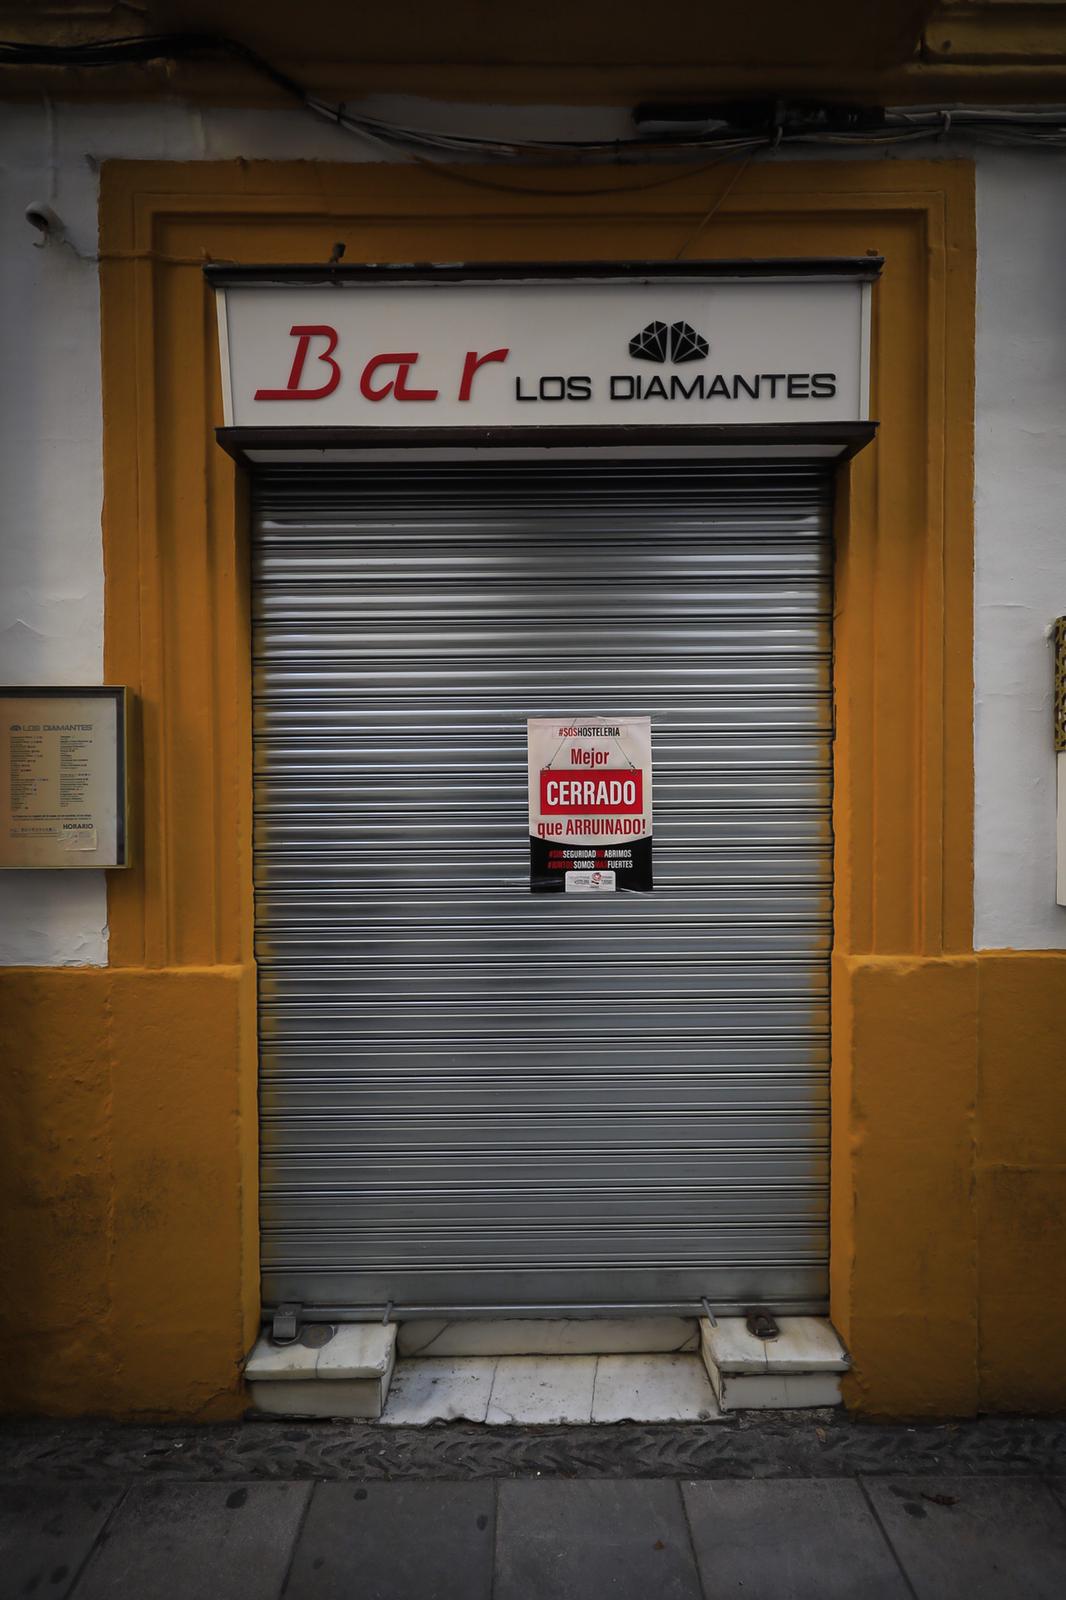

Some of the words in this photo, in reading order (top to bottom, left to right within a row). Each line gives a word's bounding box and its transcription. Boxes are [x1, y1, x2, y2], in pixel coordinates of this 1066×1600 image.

[254, 325, 510, 401] Bar
[516, 376, 592, 401] LOS
[610, 373, 837, 400] DIAMANTES
[559, 727, 620, 737] #SOSHOSTELERIA
[571, 748, 610, 768] Mejor
[546, 780, 636, 806] CERRADO
[537, 822, 563, 838] que
[566, 818, 646, 835] ARRUINADO!
